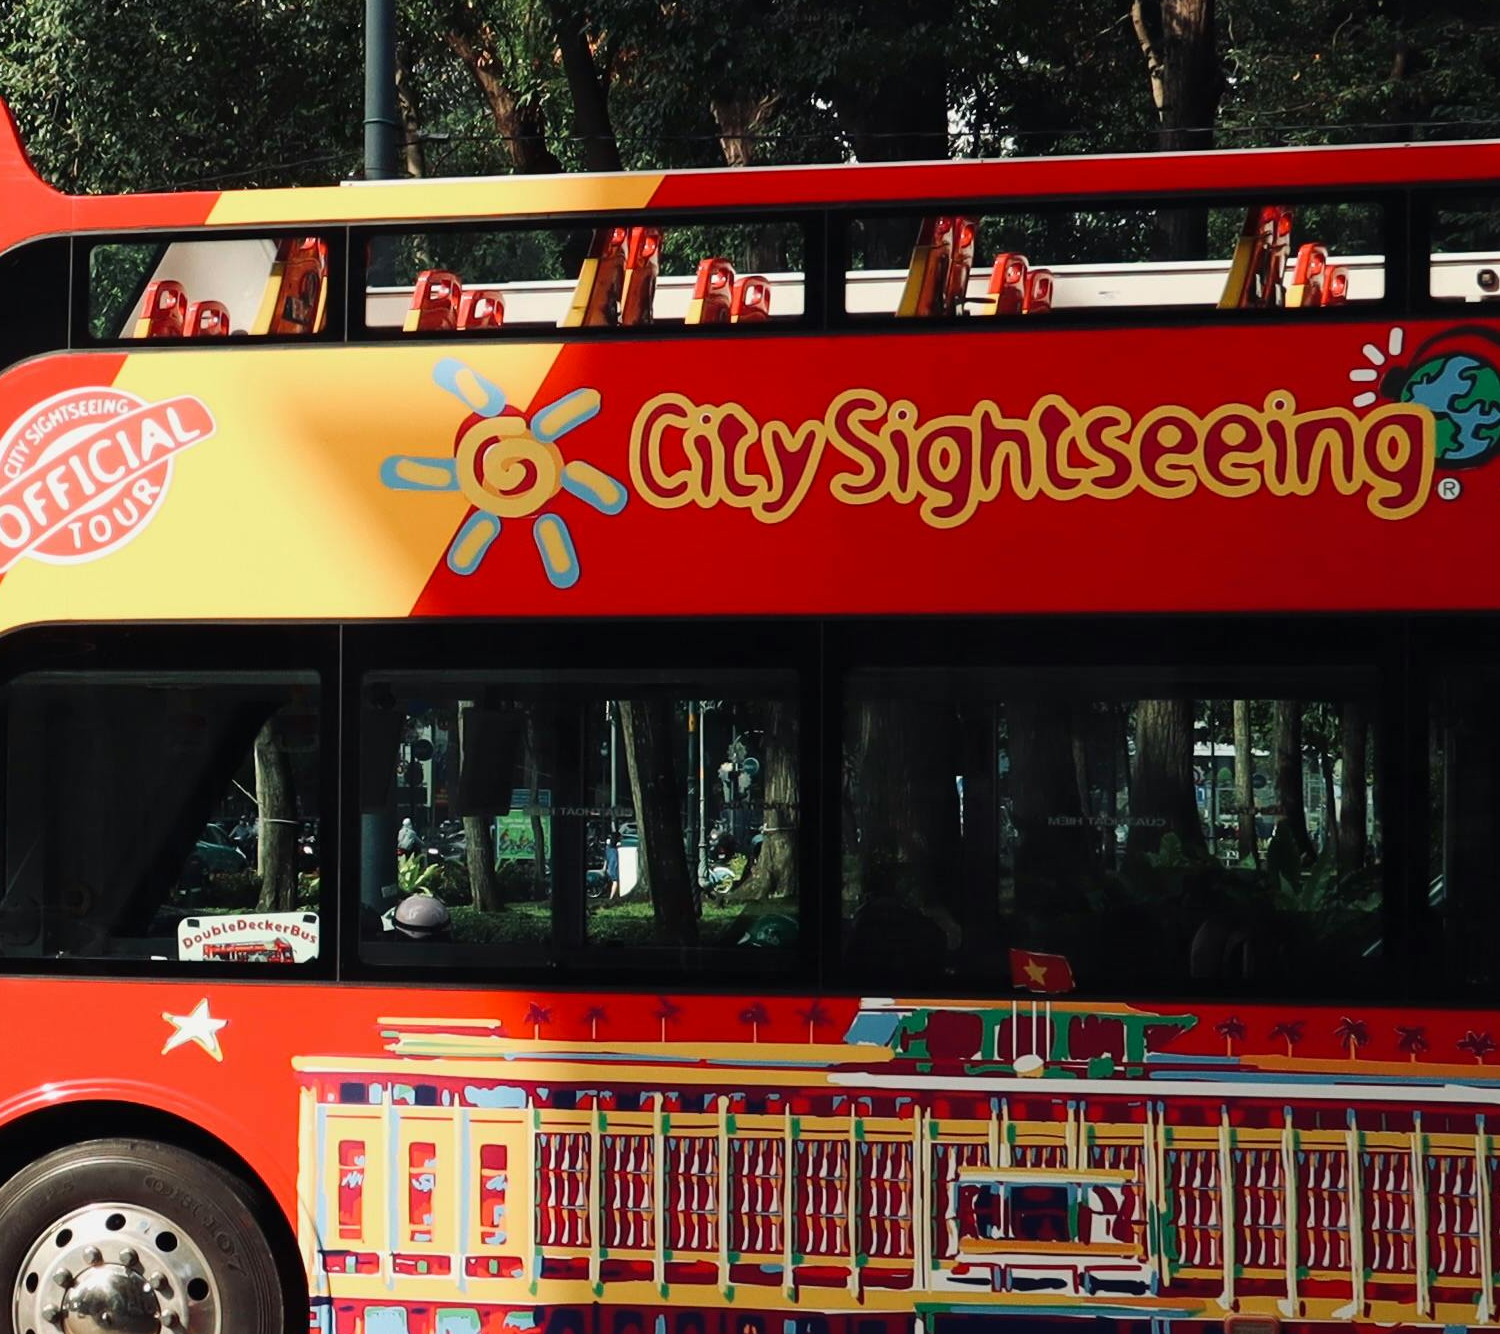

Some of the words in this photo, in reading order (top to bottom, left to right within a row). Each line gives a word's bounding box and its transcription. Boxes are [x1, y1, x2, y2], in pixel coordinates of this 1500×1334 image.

[3, 440, 29, 479] CITY
[26, 398, 129, 446] SIGHTSEEING
[68, 478, 160, 549] TOUR
[182, 919, 318, 950] DoubleDeckerBus
